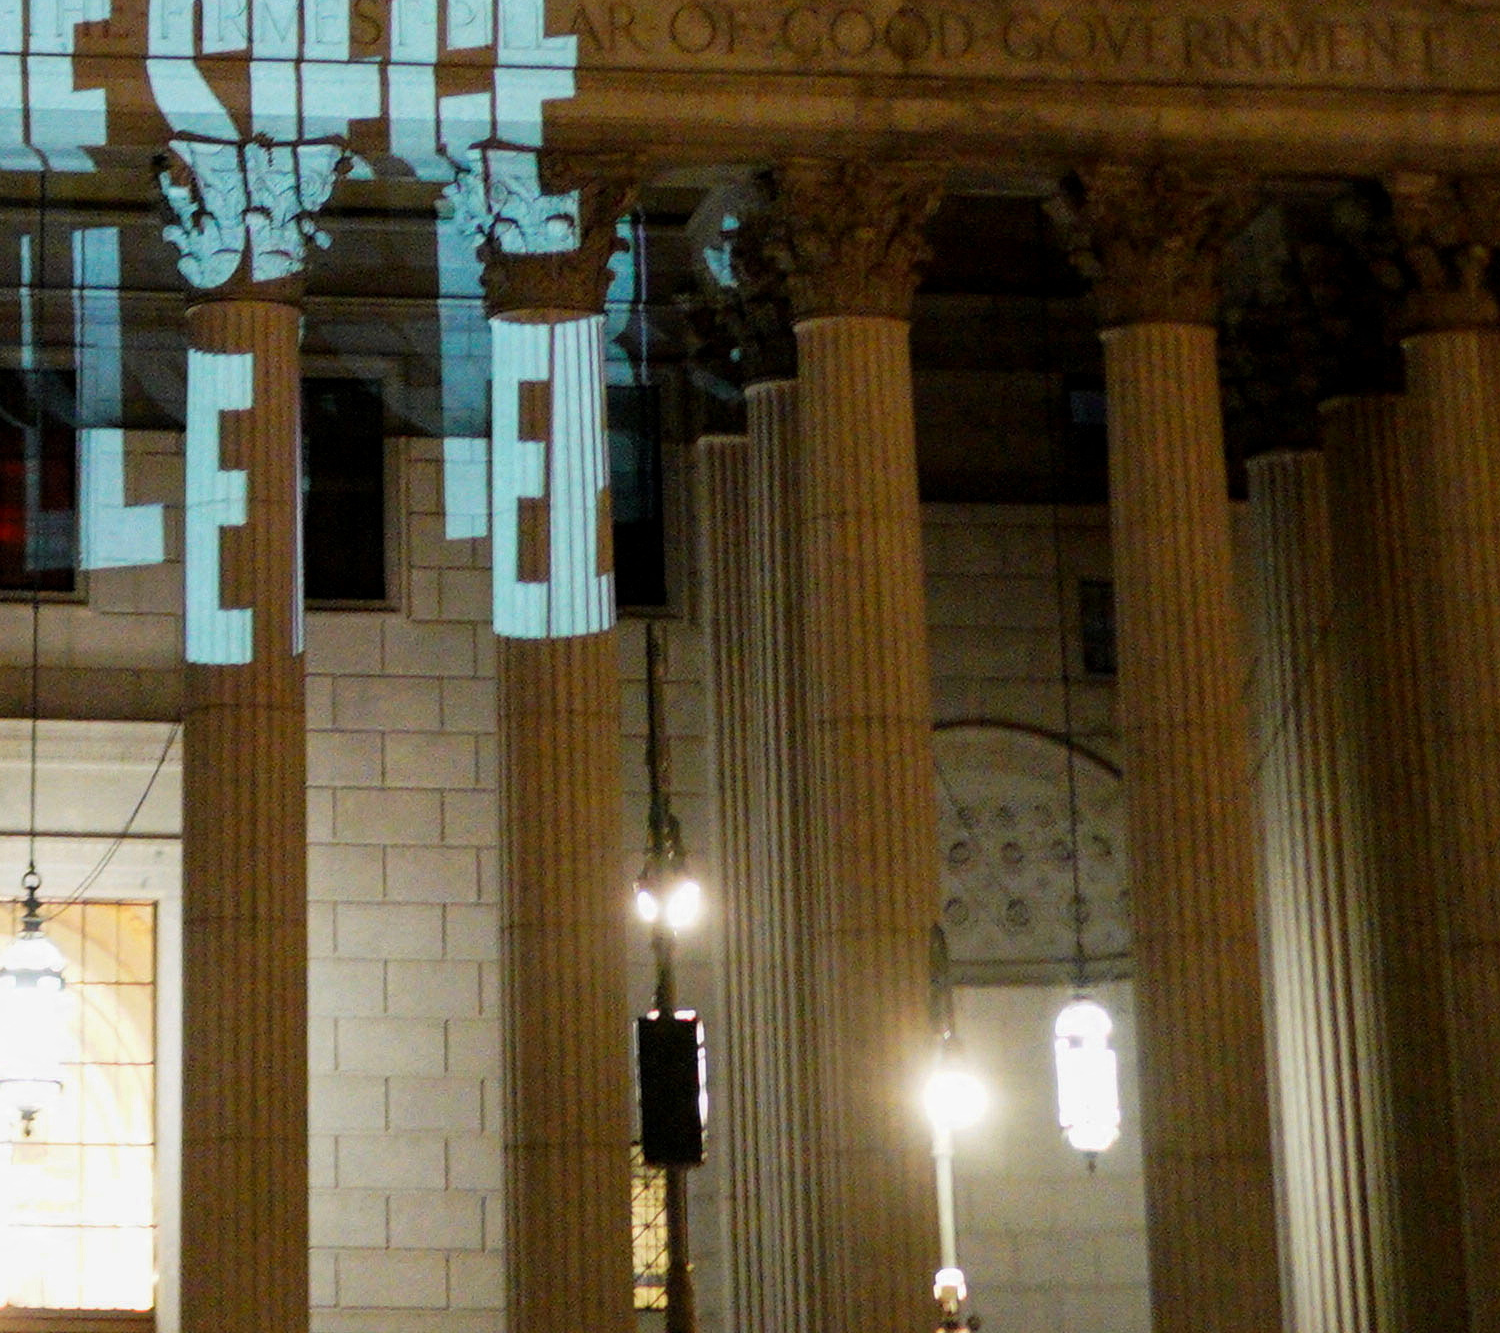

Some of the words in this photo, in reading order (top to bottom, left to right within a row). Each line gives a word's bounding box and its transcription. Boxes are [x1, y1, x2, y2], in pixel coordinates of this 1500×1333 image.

[667, 0, 752, 55] OF
[780, 3, 975, 61] GOOD
[1002, 9, 1448, 75] GOVERNMENT
